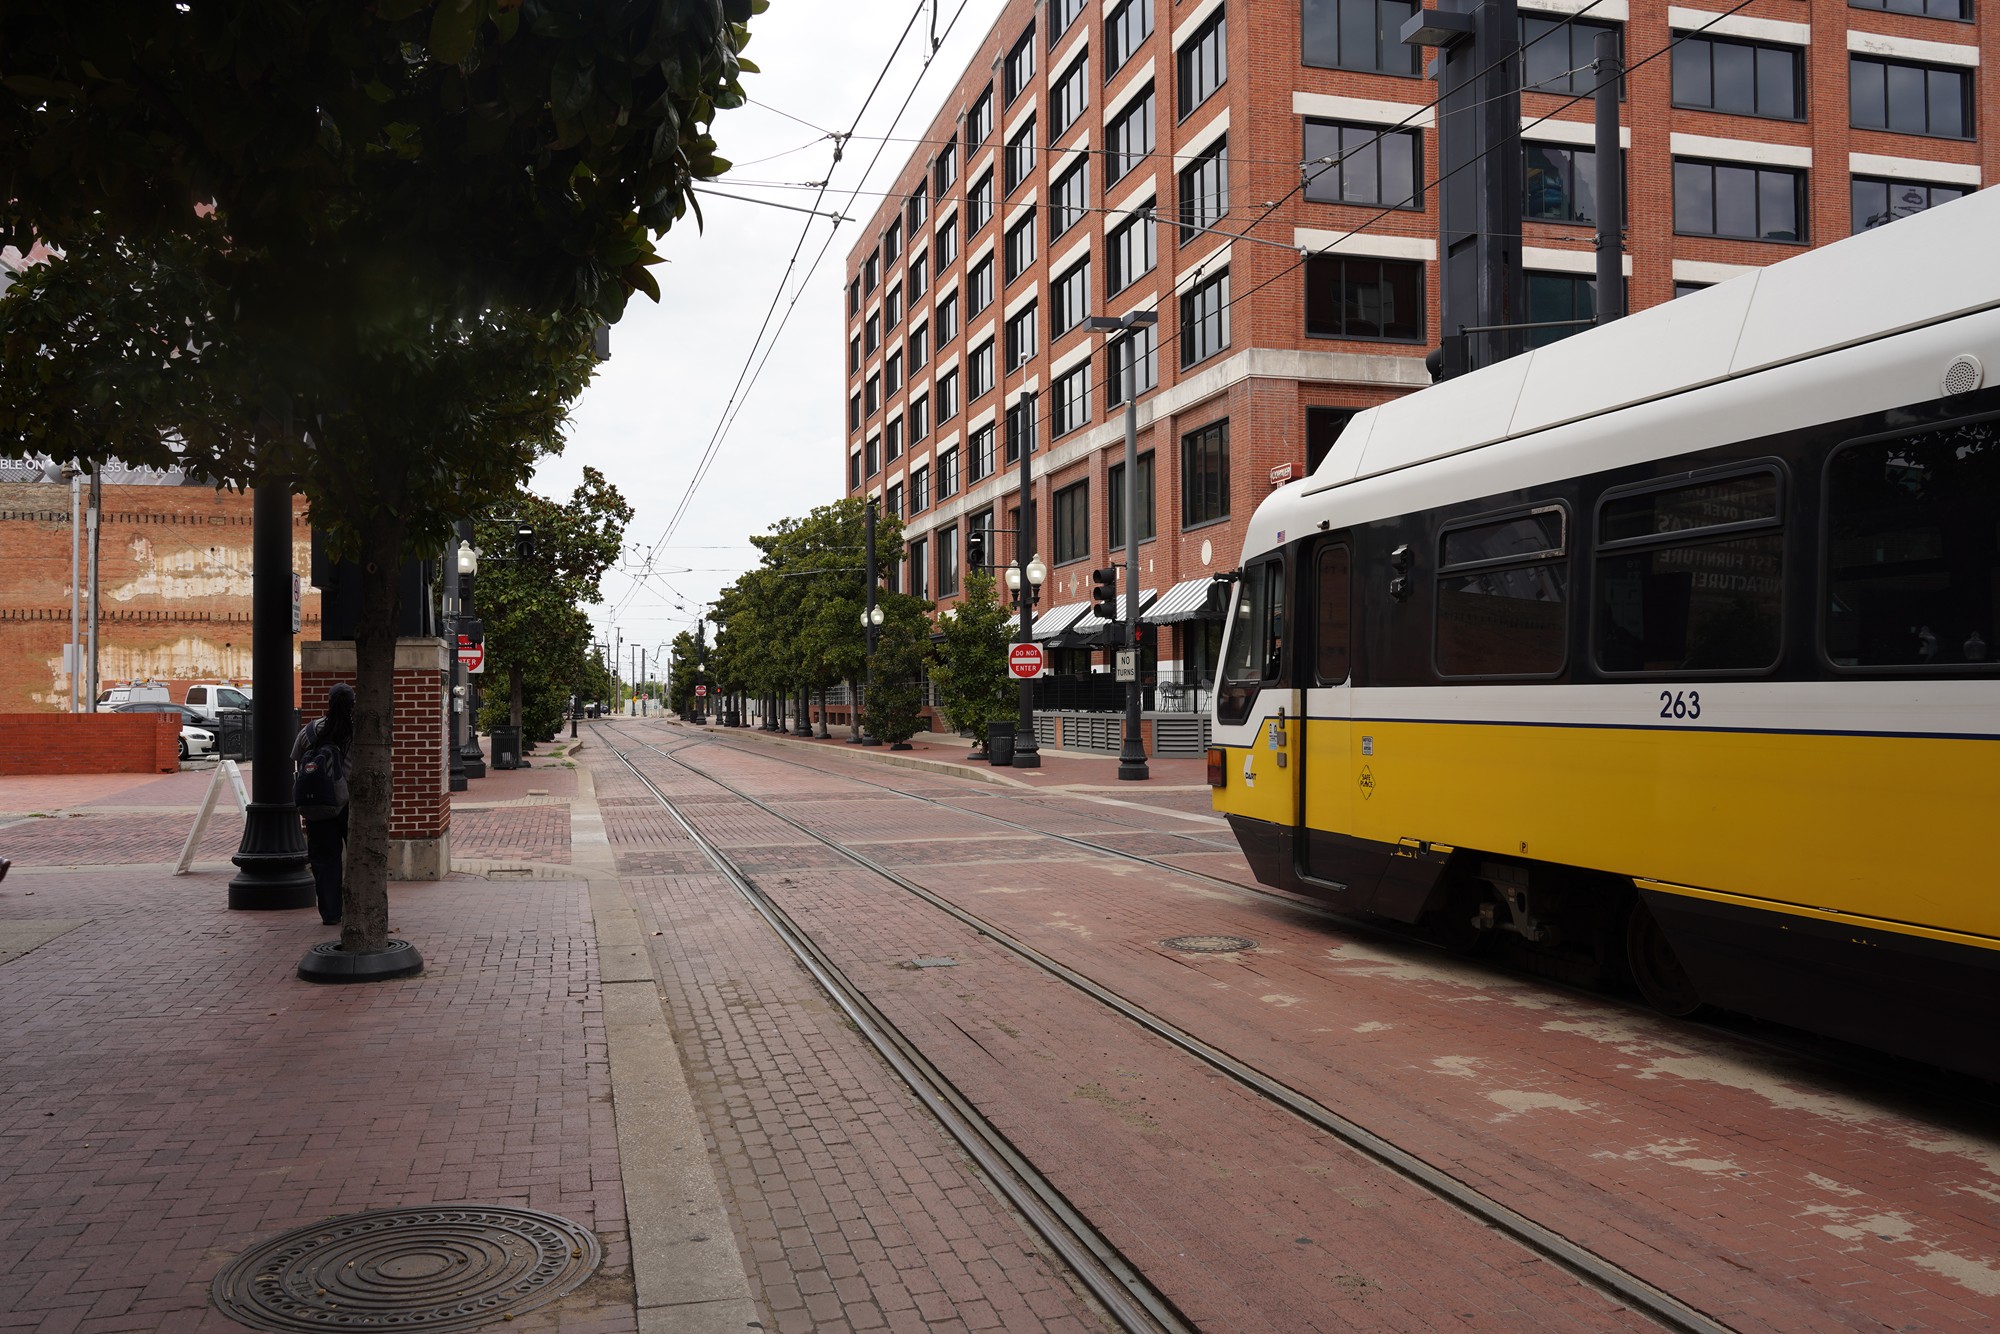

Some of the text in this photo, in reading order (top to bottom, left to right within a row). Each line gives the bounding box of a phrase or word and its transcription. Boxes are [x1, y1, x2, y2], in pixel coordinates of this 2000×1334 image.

[107, 462, 121, 472] 55
[1121, 656, 1130, 665] NO
[1117, 669, 1135, 677] TURNS
[1660, 690, 1700, 719] 263
